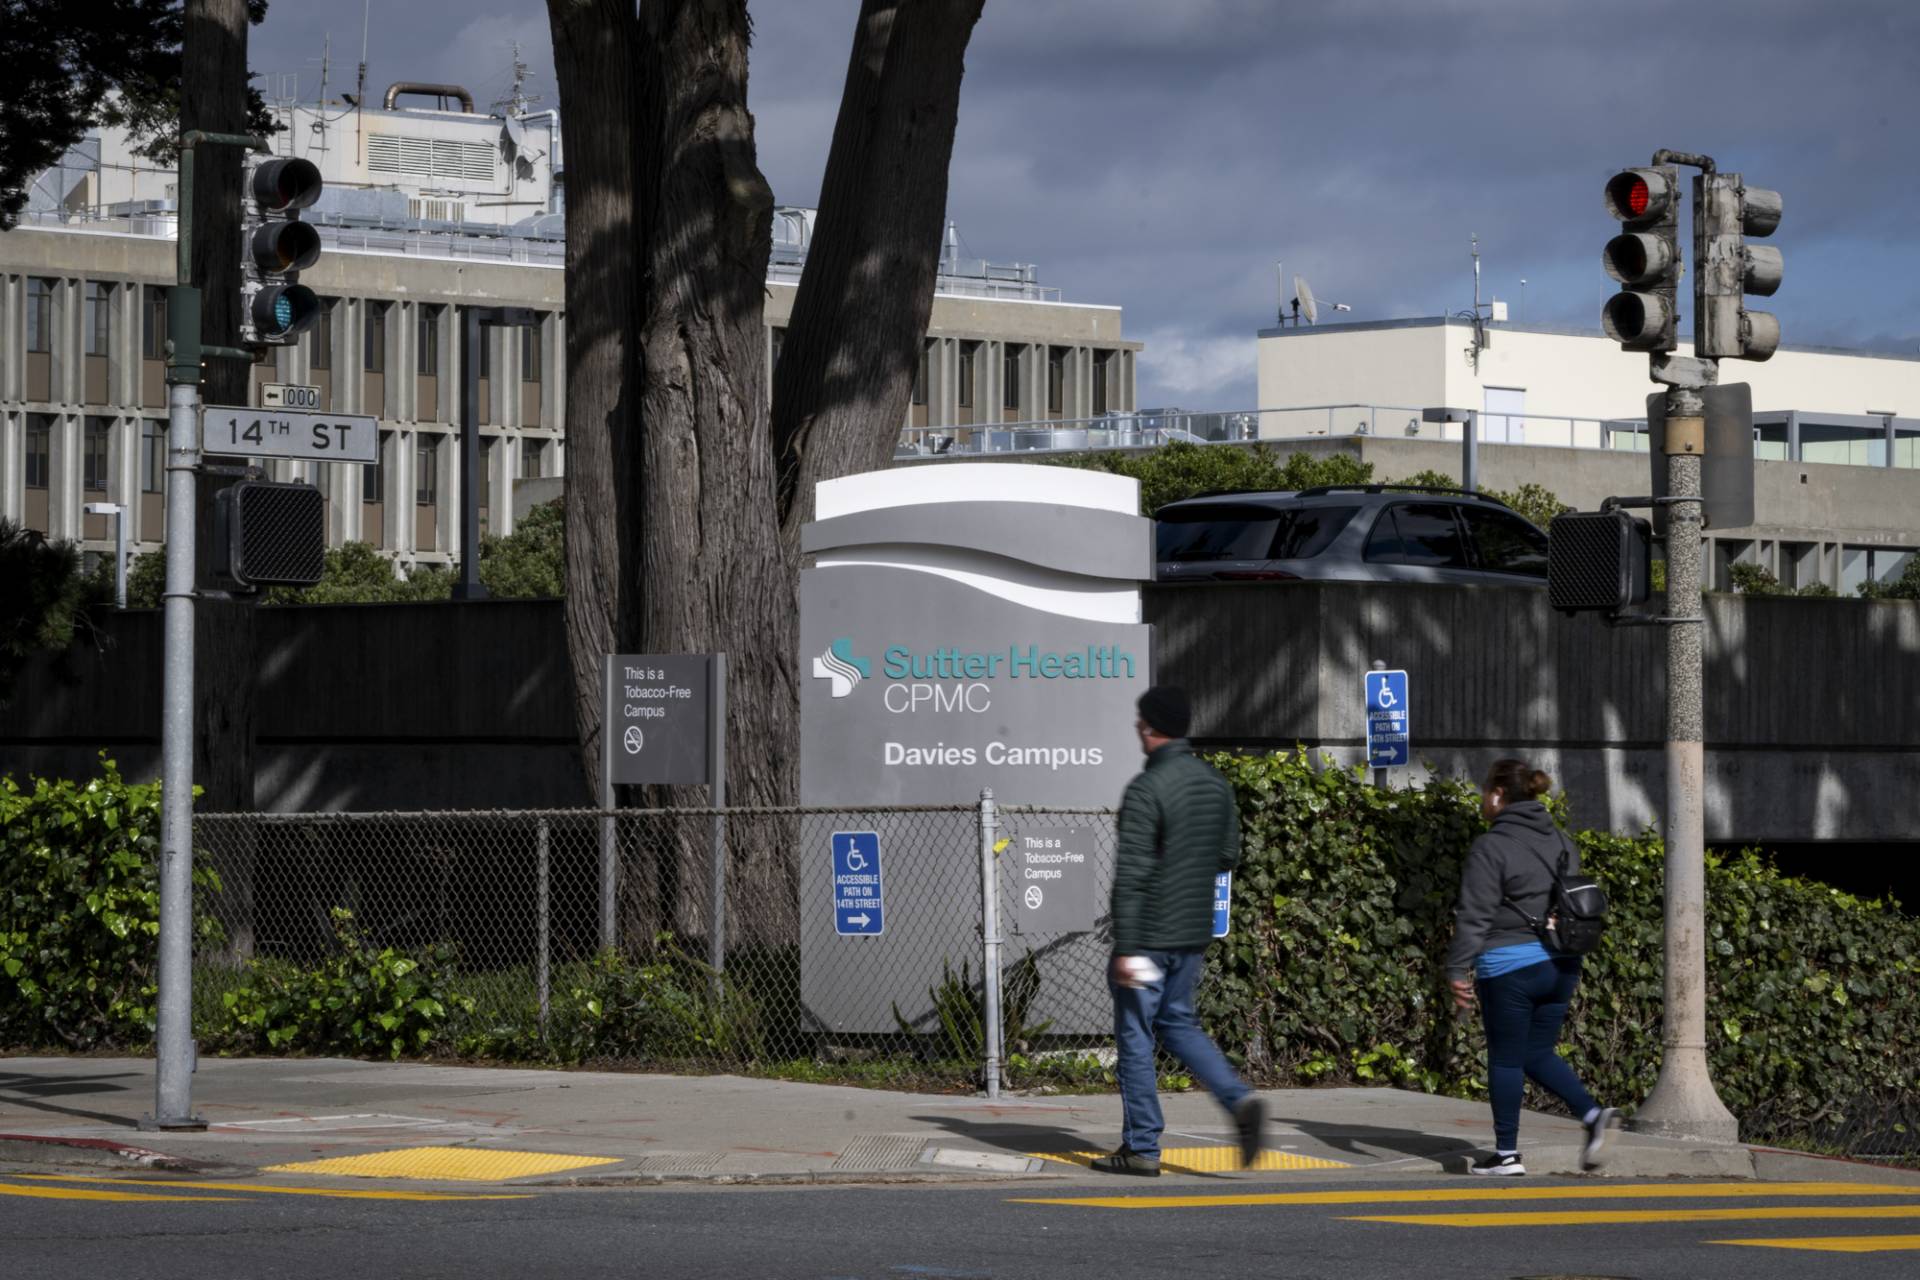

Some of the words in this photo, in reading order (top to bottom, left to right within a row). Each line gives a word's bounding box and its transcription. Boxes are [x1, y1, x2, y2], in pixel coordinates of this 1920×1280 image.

[282, 388, 315, 406] 1000
[229, 418, 290, 446] 14TH
[312, 423, 352, 450] ST
[884, 645, 1003, 679] Sutter
[1010, 645, 1135, 679] Health
[624, 666, 645, 680] This
[647, 666, 656, 680] is
[657, 669, 664, 680] a
[624, 685, 692, 699] Tobacco-Free
[884, 683, 991, 713] CPMC
[624, 704, 665, 720] Campus
[1369, 710, 1406, 721] ACCESSIBLE
[1375, 722, 1391, 732] PATH
[1391, 721, 1401, 732] ON
[1385, 732, 1407, 743] STREET
[884, 742, 977, 766] Davies
[985, 741, 1103, 770] Campus
[1024, 837, 1043, 848] This
[1045, 838, 1053, 848] is
[1055, 840, 1061, 848] a
[1024, 851, 1085, 864] Tobacco-Free
[836, 874, 879, 885] ACCESSIBLE
[1024, 868, 1062, 880] Campus
[843, 886, 861, 897] PATH
[862, 886, 873, 897] ON
[836, 899, 854, 909] 14TH
[855, 899, 881, 909] STREET
